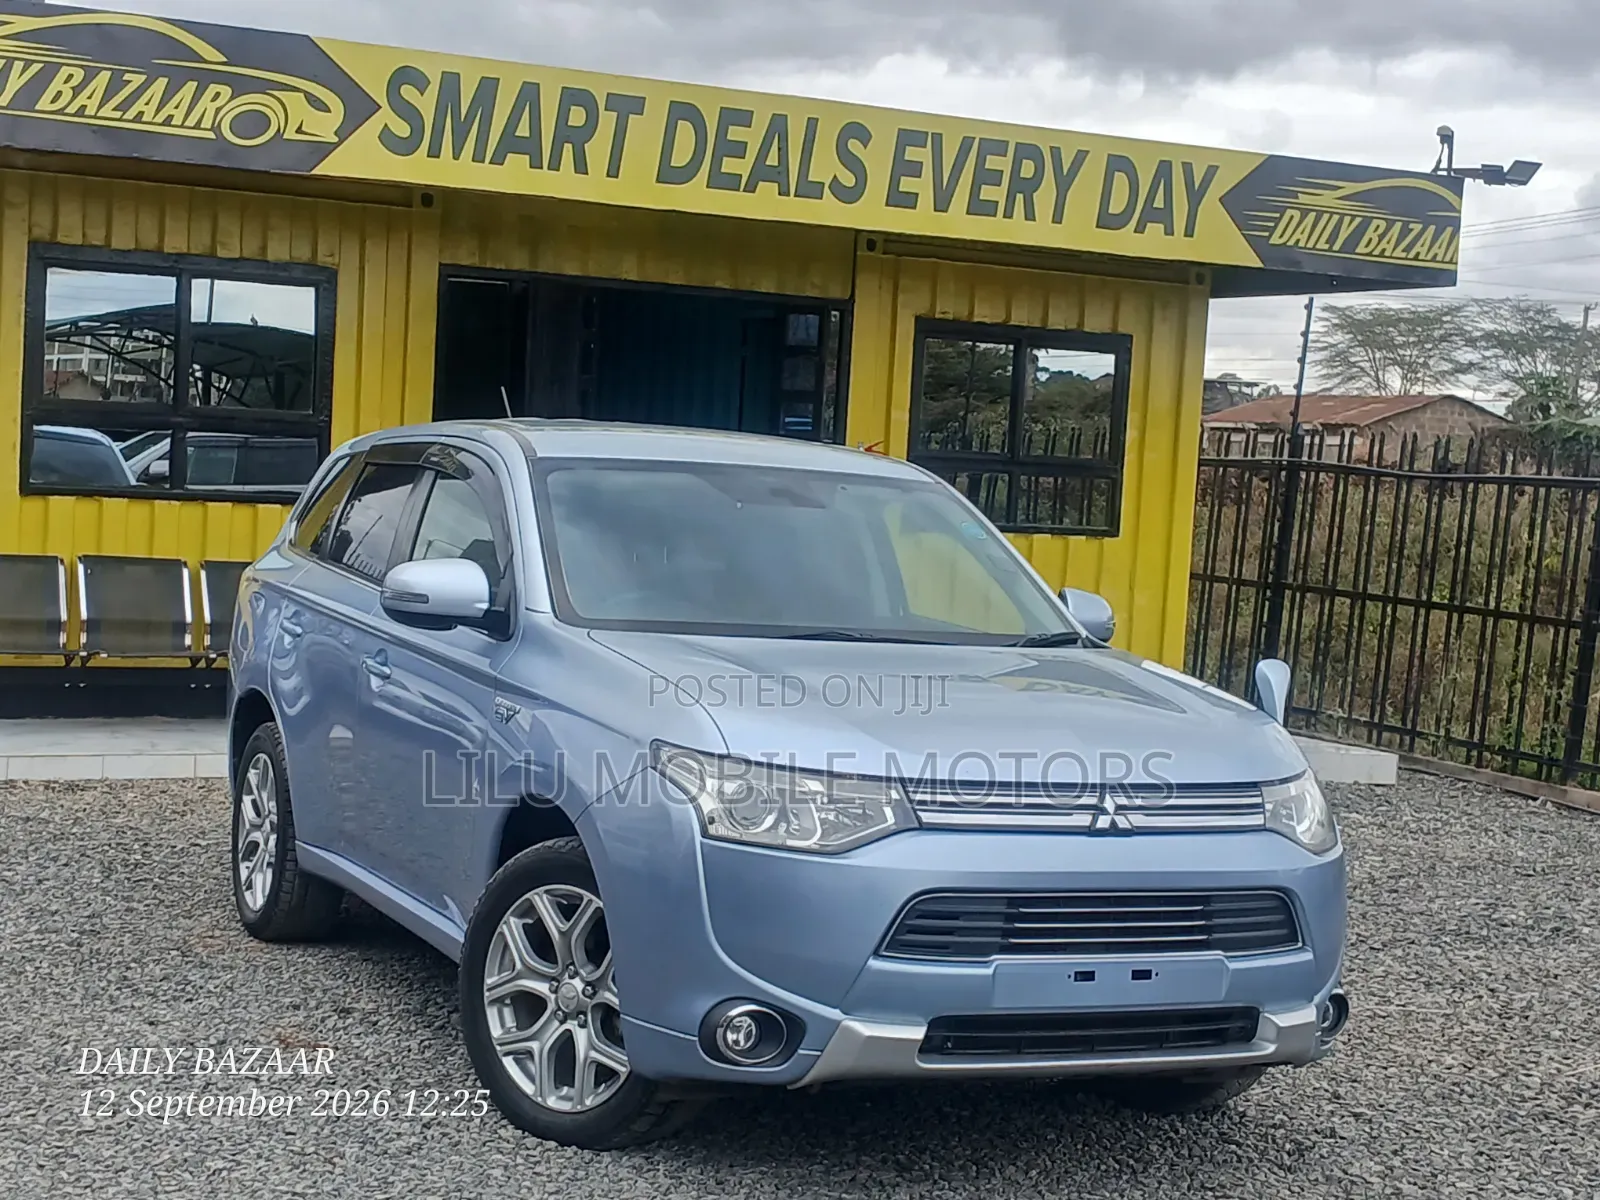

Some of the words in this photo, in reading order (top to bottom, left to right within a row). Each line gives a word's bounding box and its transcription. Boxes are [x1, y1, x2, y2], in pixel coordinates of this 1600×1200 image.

[34, 65, 232, 129] BAZAAR
[378, 65, 646, 179] SMART
[656, 100, 872, 204] DEALS
[884, 128, 1090, 224] EVERY
[1095, 153, 1220, 238] DAY
[1269, 208, 1363, 251] DAILY
